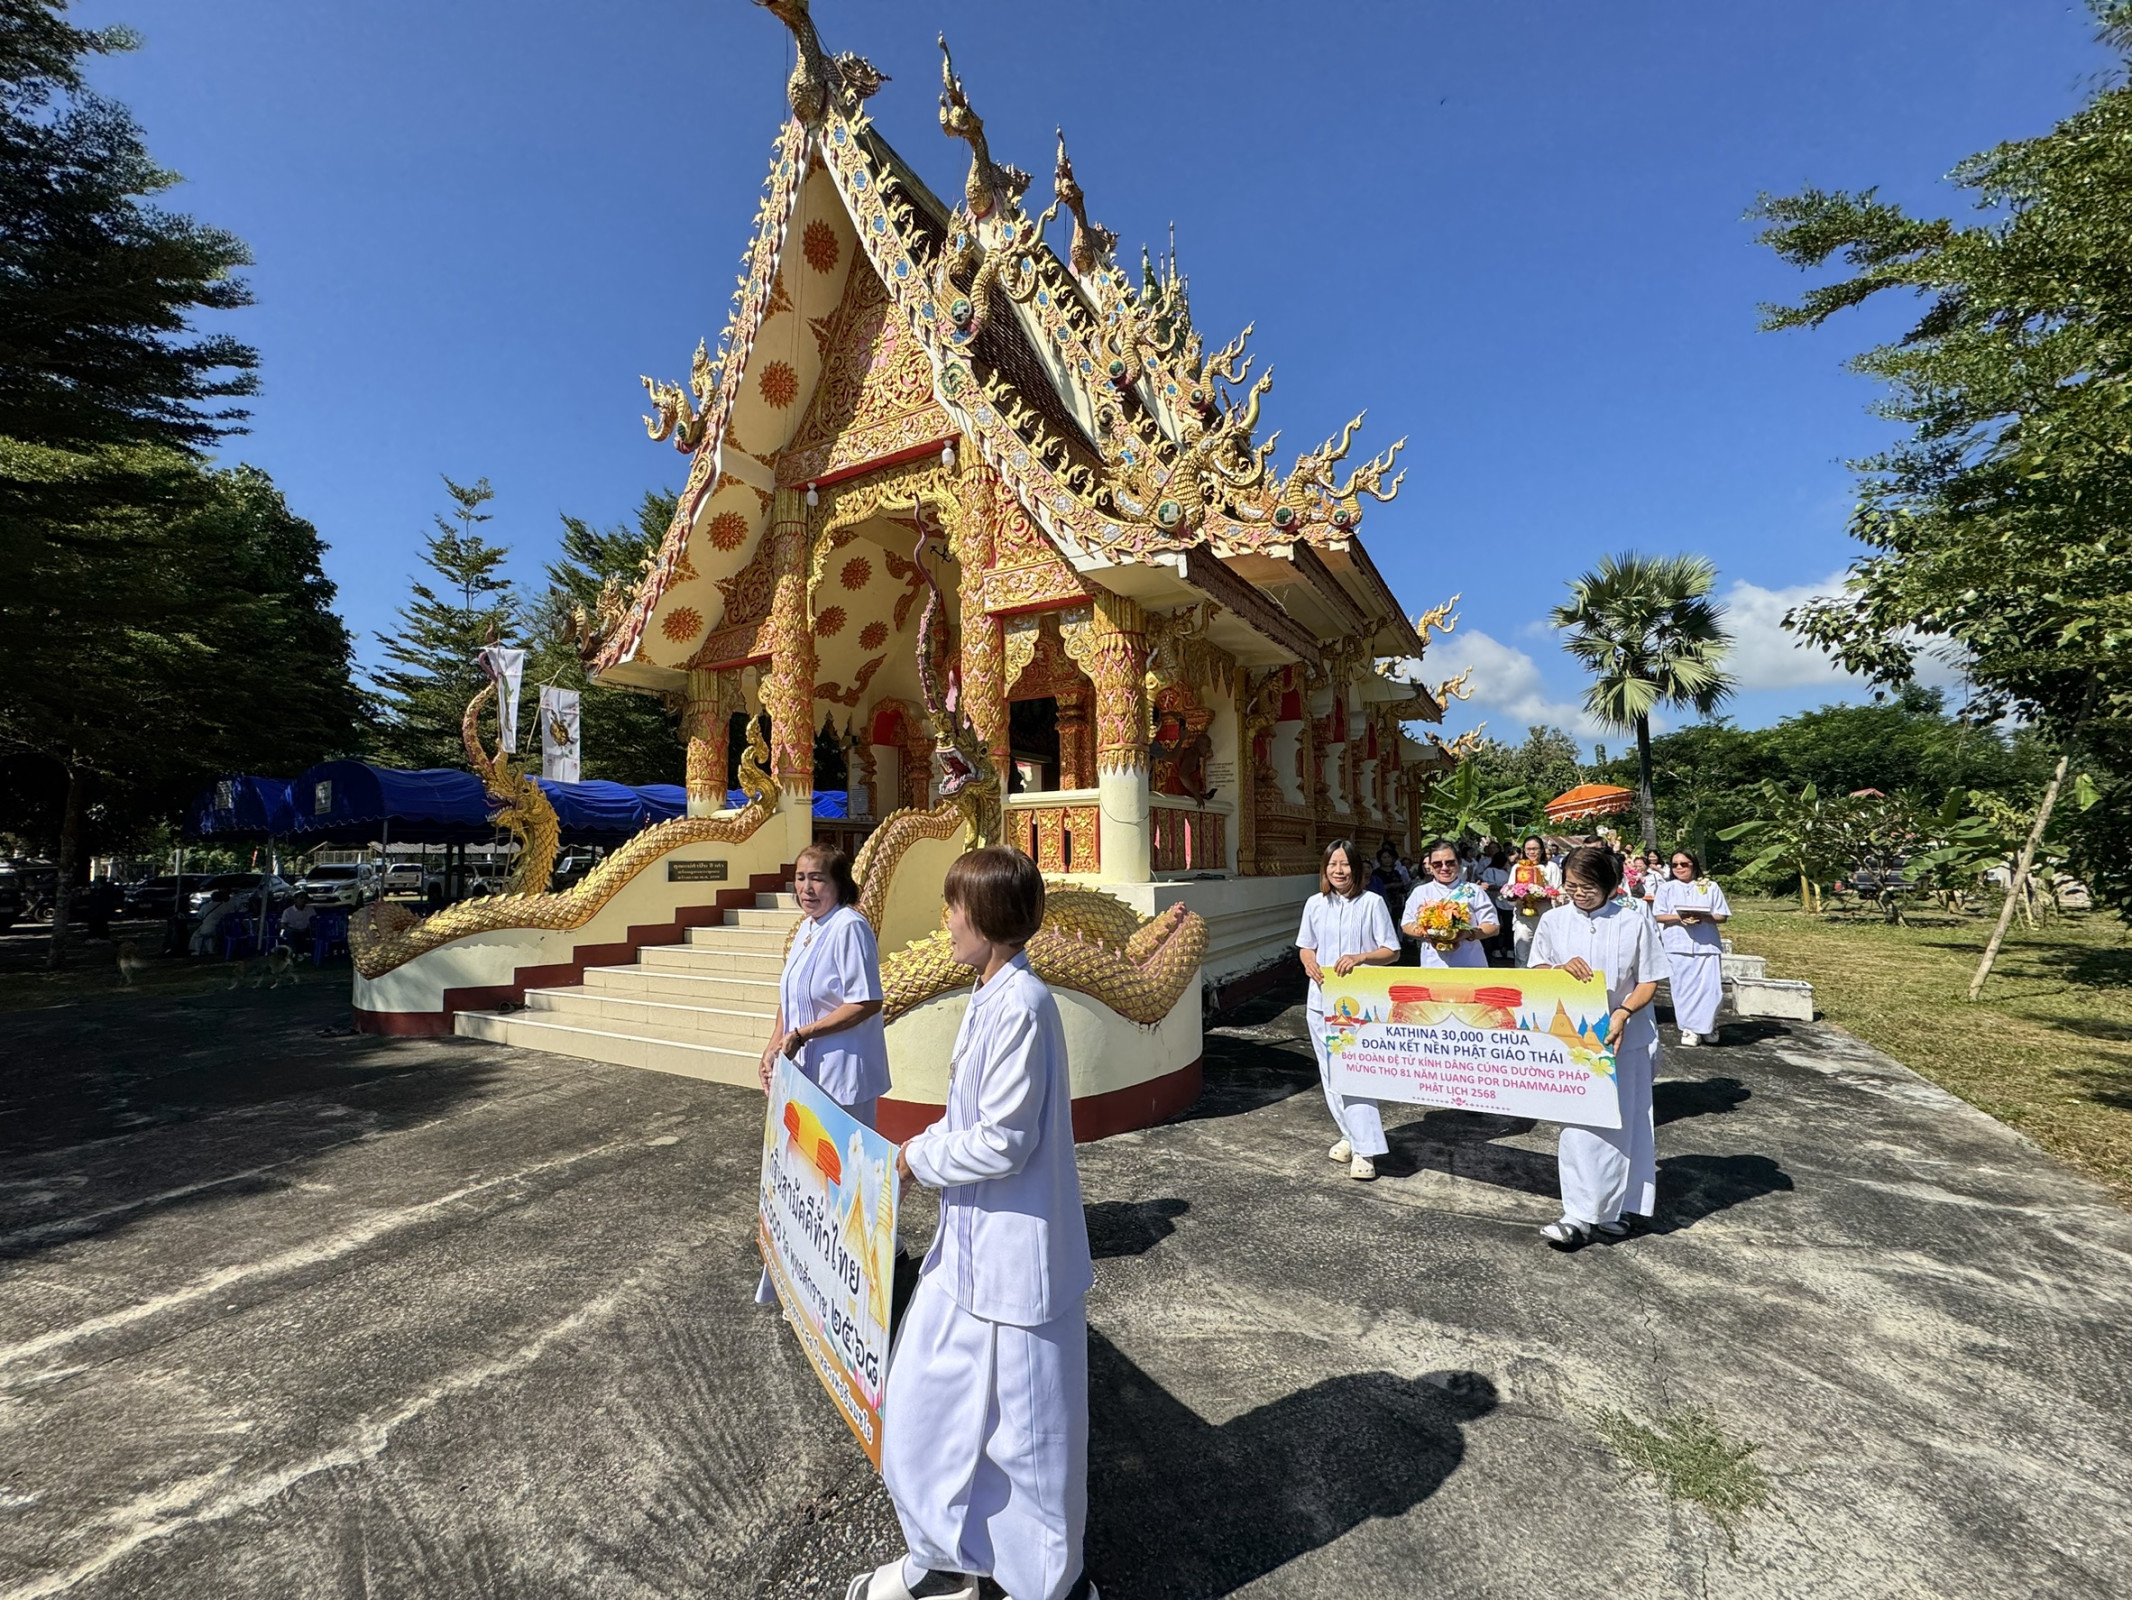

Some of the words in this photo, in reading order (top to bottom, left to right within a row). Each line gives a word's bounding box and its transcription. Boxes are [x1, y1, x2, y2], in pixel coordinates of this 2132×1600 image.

[1386, 1026, 1438, 1040] KATHINA
[1442, 1029, 1483, 1043] 30,000
[1491, 1031, 1530, 1046] CHÙA
[1362, 1037, 1395, 1051] ĐOÀN
[1399, 1038, 1420, 1052] KẾT
[1454, 1044, 1486, 1060] PHẬT
[1491, 1046, 1525, 1061] GIÁO
[1529, 1050, 1563, 1064] THÁI
[1346, 1062, 1376, 1074] MỪNG
[1378, 1066, 1398, 1077] THỌ
[1400, 1069, 1412, 1078] 81
[1414, 1069, 1438, 1080] NĂM
[1440, 1073, 1475, 1084] LUANG
[1478, 1076, 1500, 1087] POR
[1502, 1078, 1586, 1095] DHAMMAJAYO
[1358, 1053, 1385, 1063] ĐOÀN
[1387, 1054, 1399, 1066] ĐỆ
[1418, 1056, 1442, 1068] KÍNH
[1445, 1059, 1474, 1072] DÂNG
[1477, 1062, 1508, 1074] CÚNG
[1511, 1065, 1555, 1078] DƯỜNG
[1558, 1069, 1591, 1081] PHÁP
[1419, 1082, 1443, 1094] PHẬT
[1447, 1085, 1468, 1097] LỊCH
[1471, 1088, 1496, 1099] 2568
[832, 1298, 878, 1387] ๒๕๖๘
